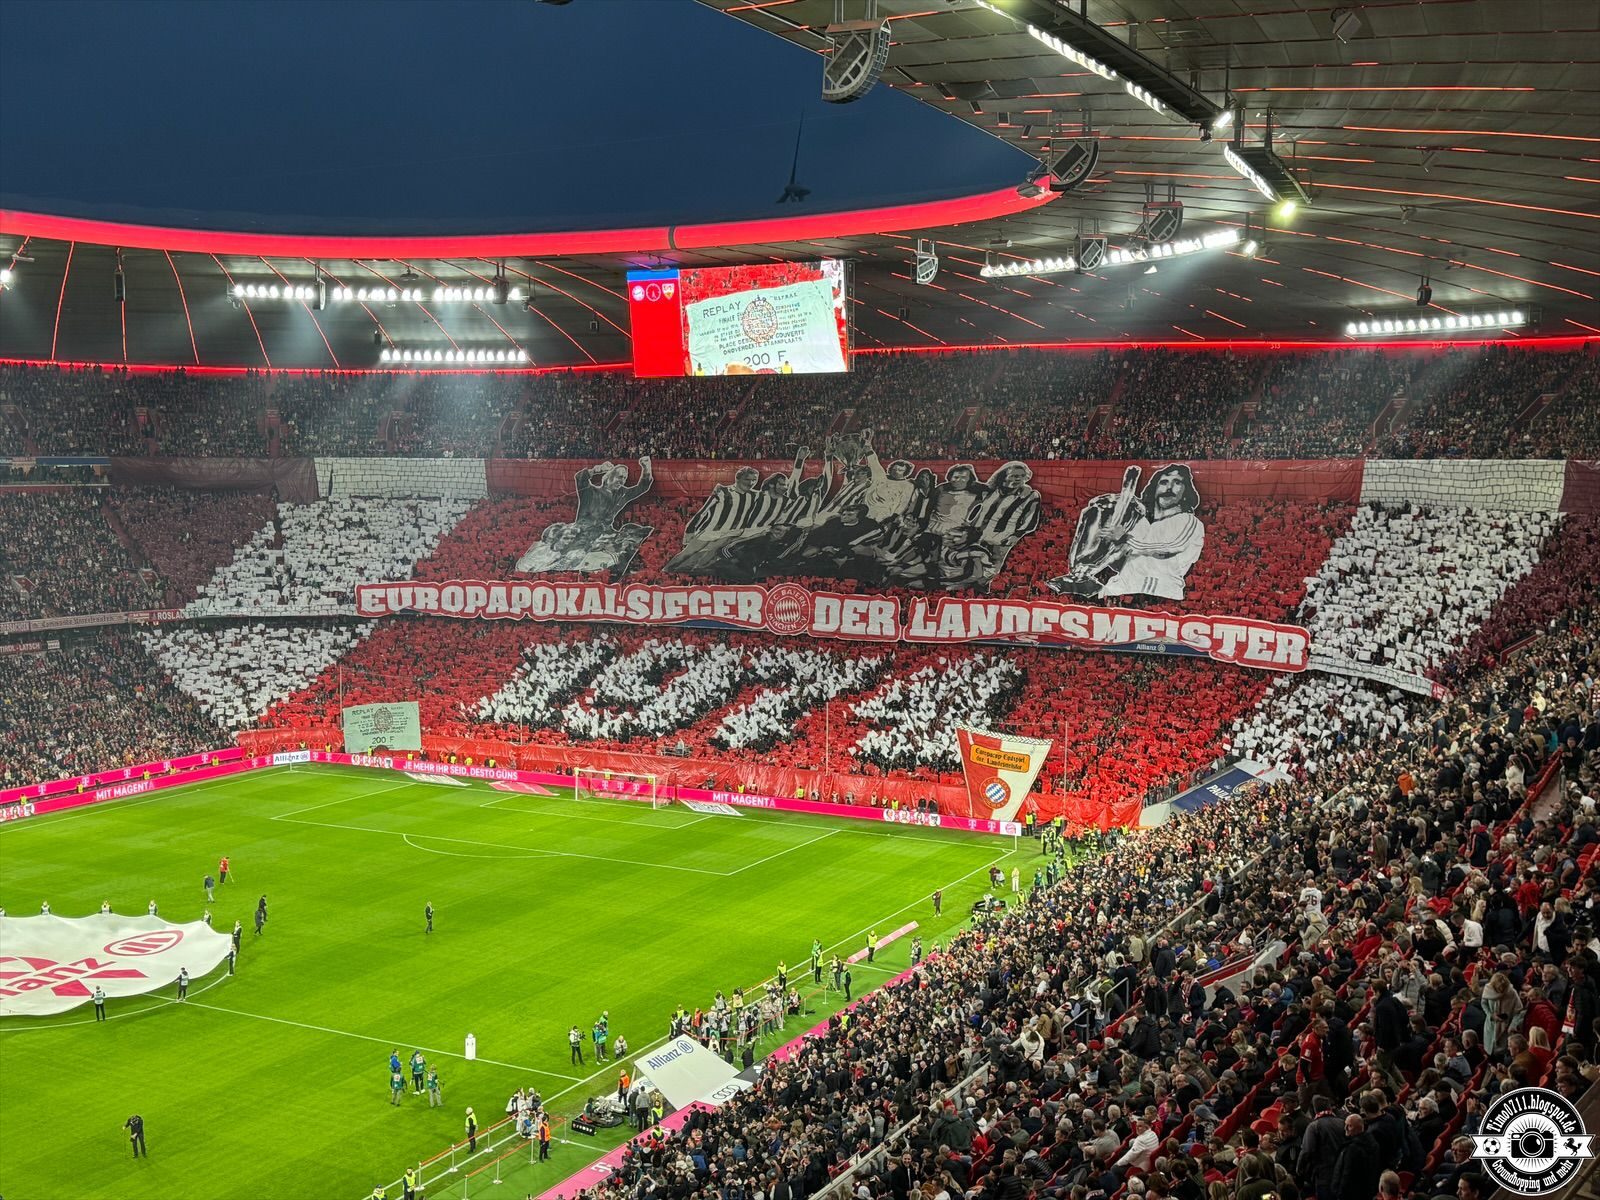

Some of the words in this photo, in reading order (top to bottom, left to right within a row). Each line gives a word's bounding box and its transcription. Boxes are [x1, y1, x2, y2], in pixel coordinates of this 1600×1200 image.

[703, 301, 741, 318] REPLAY
[743, 352, 770, 367] 200
[777, 350, 786, 362] F
[359, 585, 763, 624] EUROPAPOKALSIEGER
[813, 595, 897, 638] DER
[909, 597, 1307, 666] LANDESMEISTER
[352, 708, 373, 716] REPLAY
[372, 736, 387, 745] 200
[389, 735, 395, 743] F
[274, 754, 299, 762] Allianz
[403, 761, 412, 770] JE
[414, 762, 434, 772] MEHR
[436, 764, 449, 774] IHR
[450, 765, 469, 776] SEID,
[470, 767, 494, 778] DESTO
[96, 788, 112, 801] MIT
[113, 780, 155, 798] MAGENTA
[713, 792, 728, 802] MIT
[731, 795, 776, 808] MAGENTA
[646, 1047, 682, 1071] Allianz
